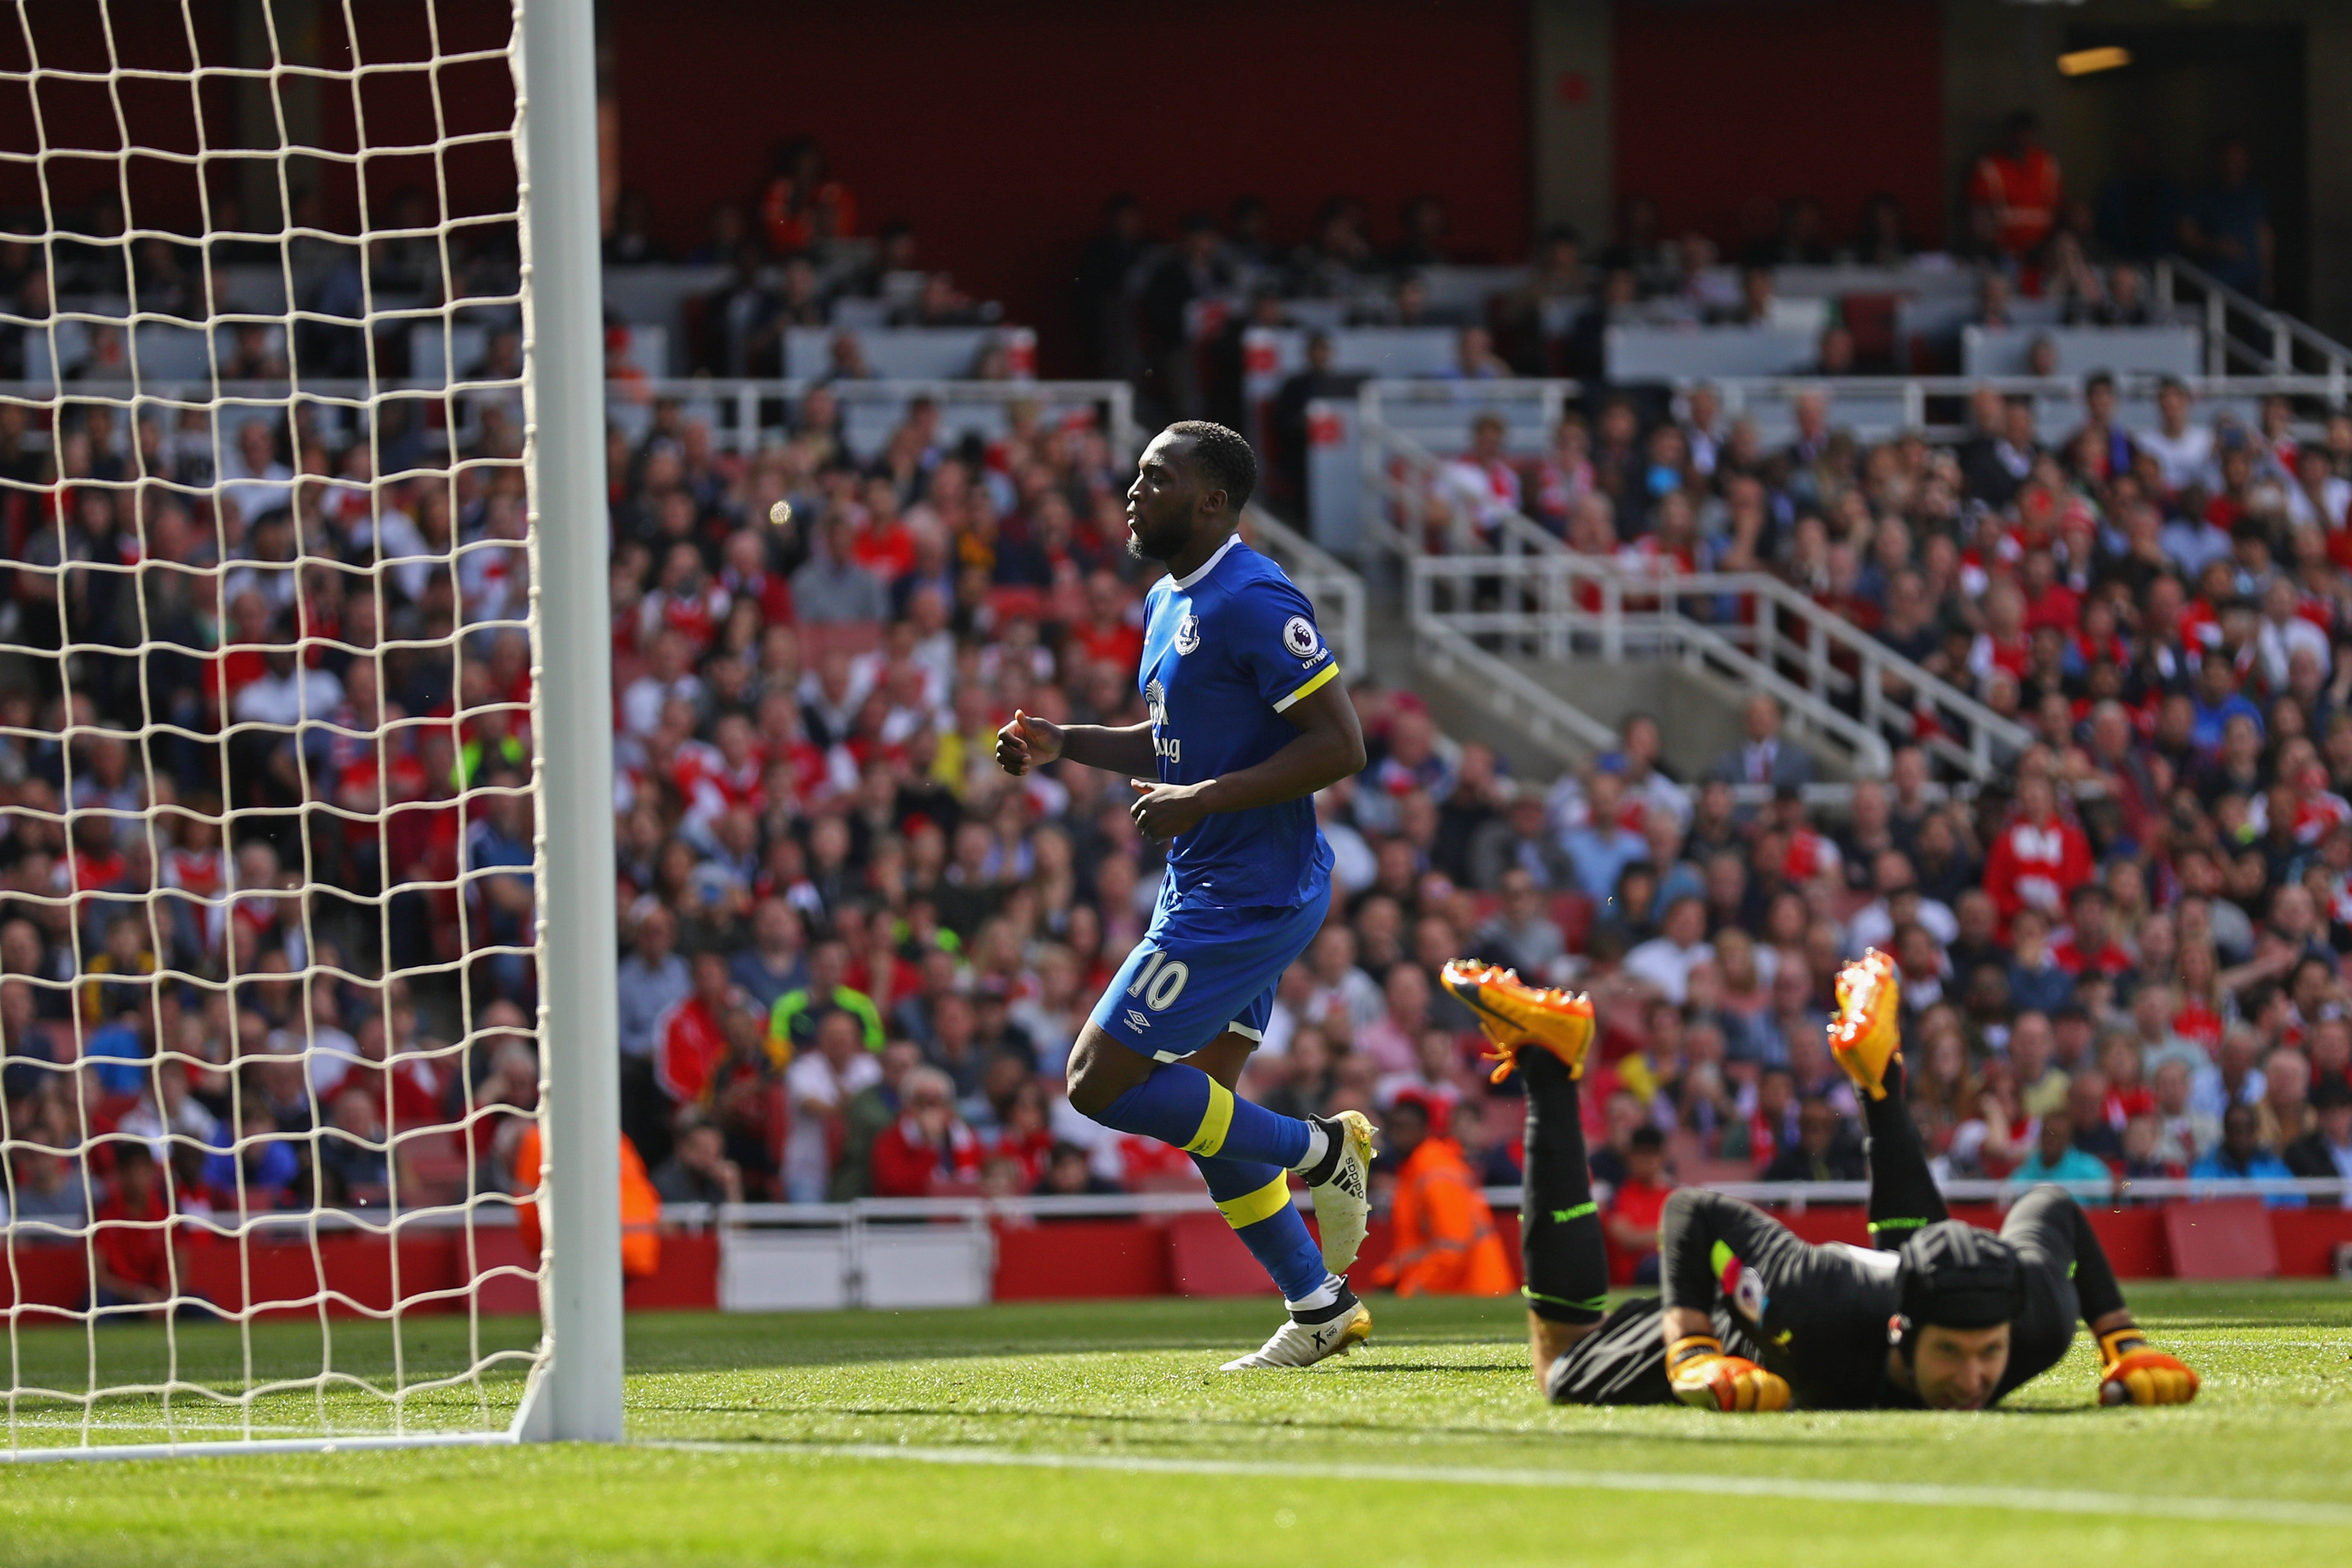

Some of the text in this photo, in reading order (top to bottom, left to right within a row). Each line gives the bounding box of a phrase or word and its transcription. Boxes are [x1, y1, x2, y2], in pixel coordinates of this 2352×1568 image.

[1127, 951, 1189, 1012] 10
[1123, 1018, 1143, 1035] umbro
[1346, 1157, 1364, 1199] adidas
